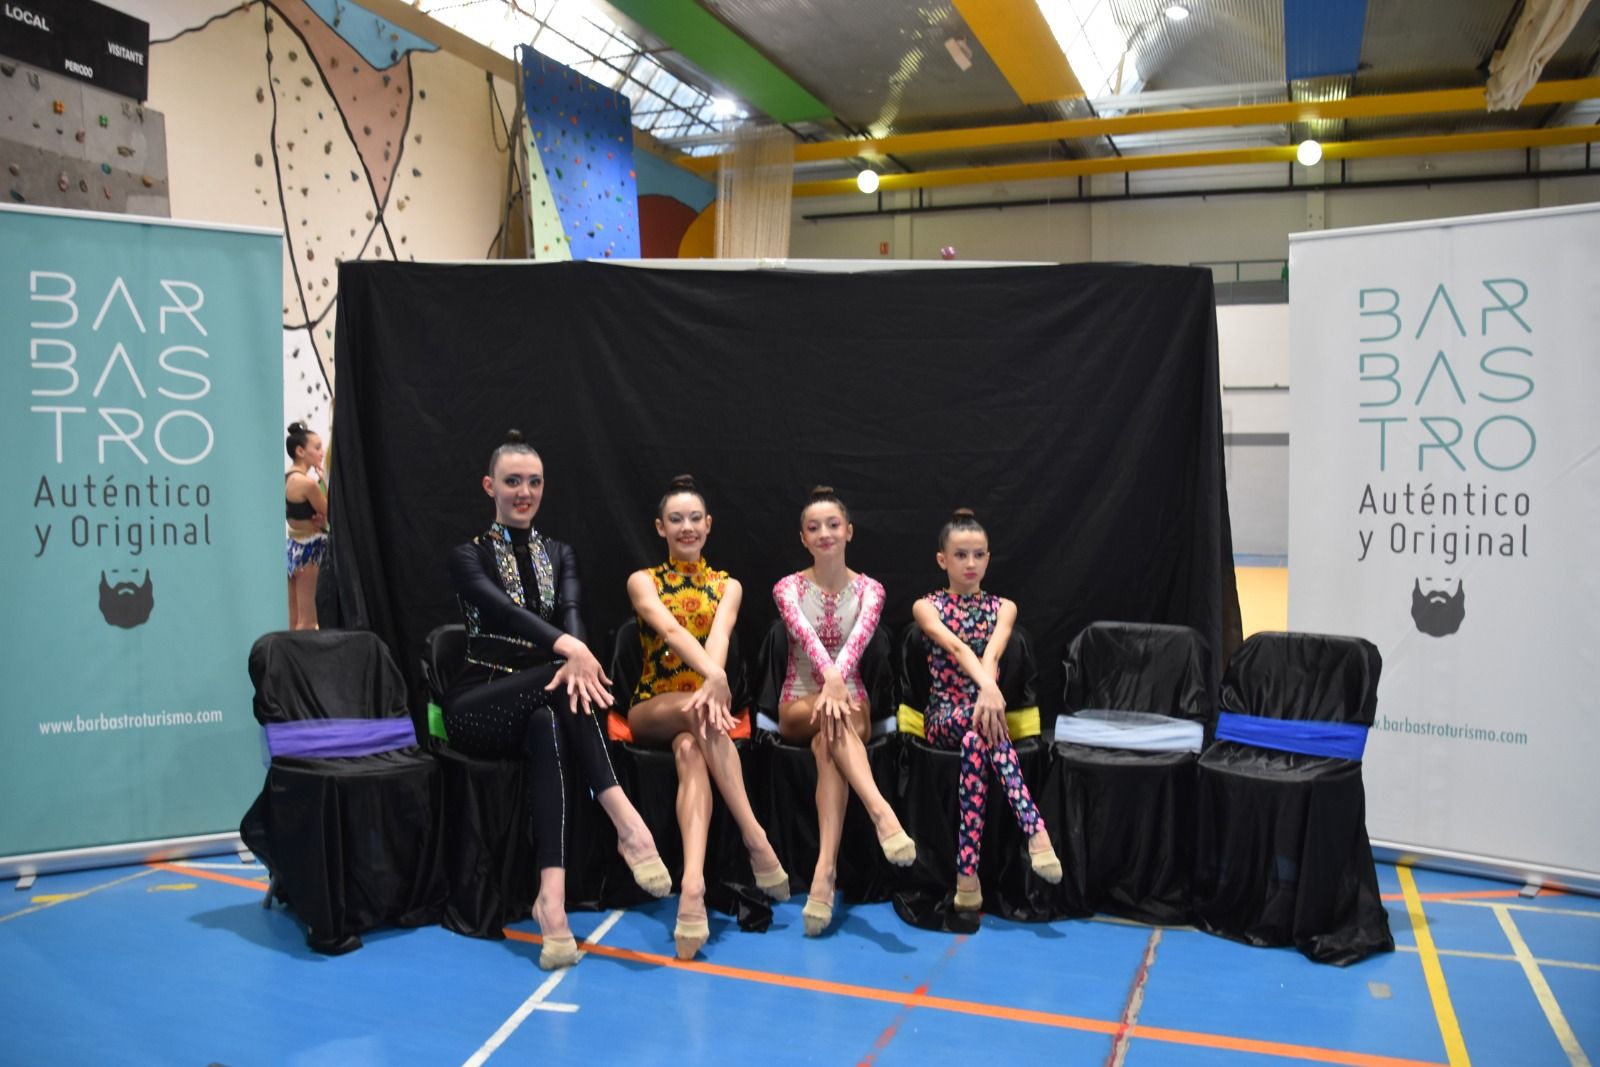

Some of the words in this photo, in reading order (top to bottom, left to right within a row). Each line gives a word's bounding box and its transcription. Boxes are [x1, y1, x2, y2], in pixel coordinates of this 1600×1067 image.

[5, 3, 50, 31] LOCAL
[64, 59, 93, 78] PERIODO
[107, 41, 144, 66] VISITANTE
[30, 271, 208, 337] BAR
[1359, 278, 1533, 343] BAR
[30, 338, 212, 401] BAS
[1359, 346, 1535, 408] BAS
[30, 406, 214, 465] TRO
[1358, 414, 1537, 472] TRO
[33, 474, 211, 508] Auténtico
[1358, 483, 1531, 517] Auténtico
[34, 523, 52, 558] y
[71, 514, 212, 556] Original
[1357, 529, 1374, 562] y
[1390, 522, 1529, 565] Original
[39, 709, 223, 735] www.barbastroturismo.com
